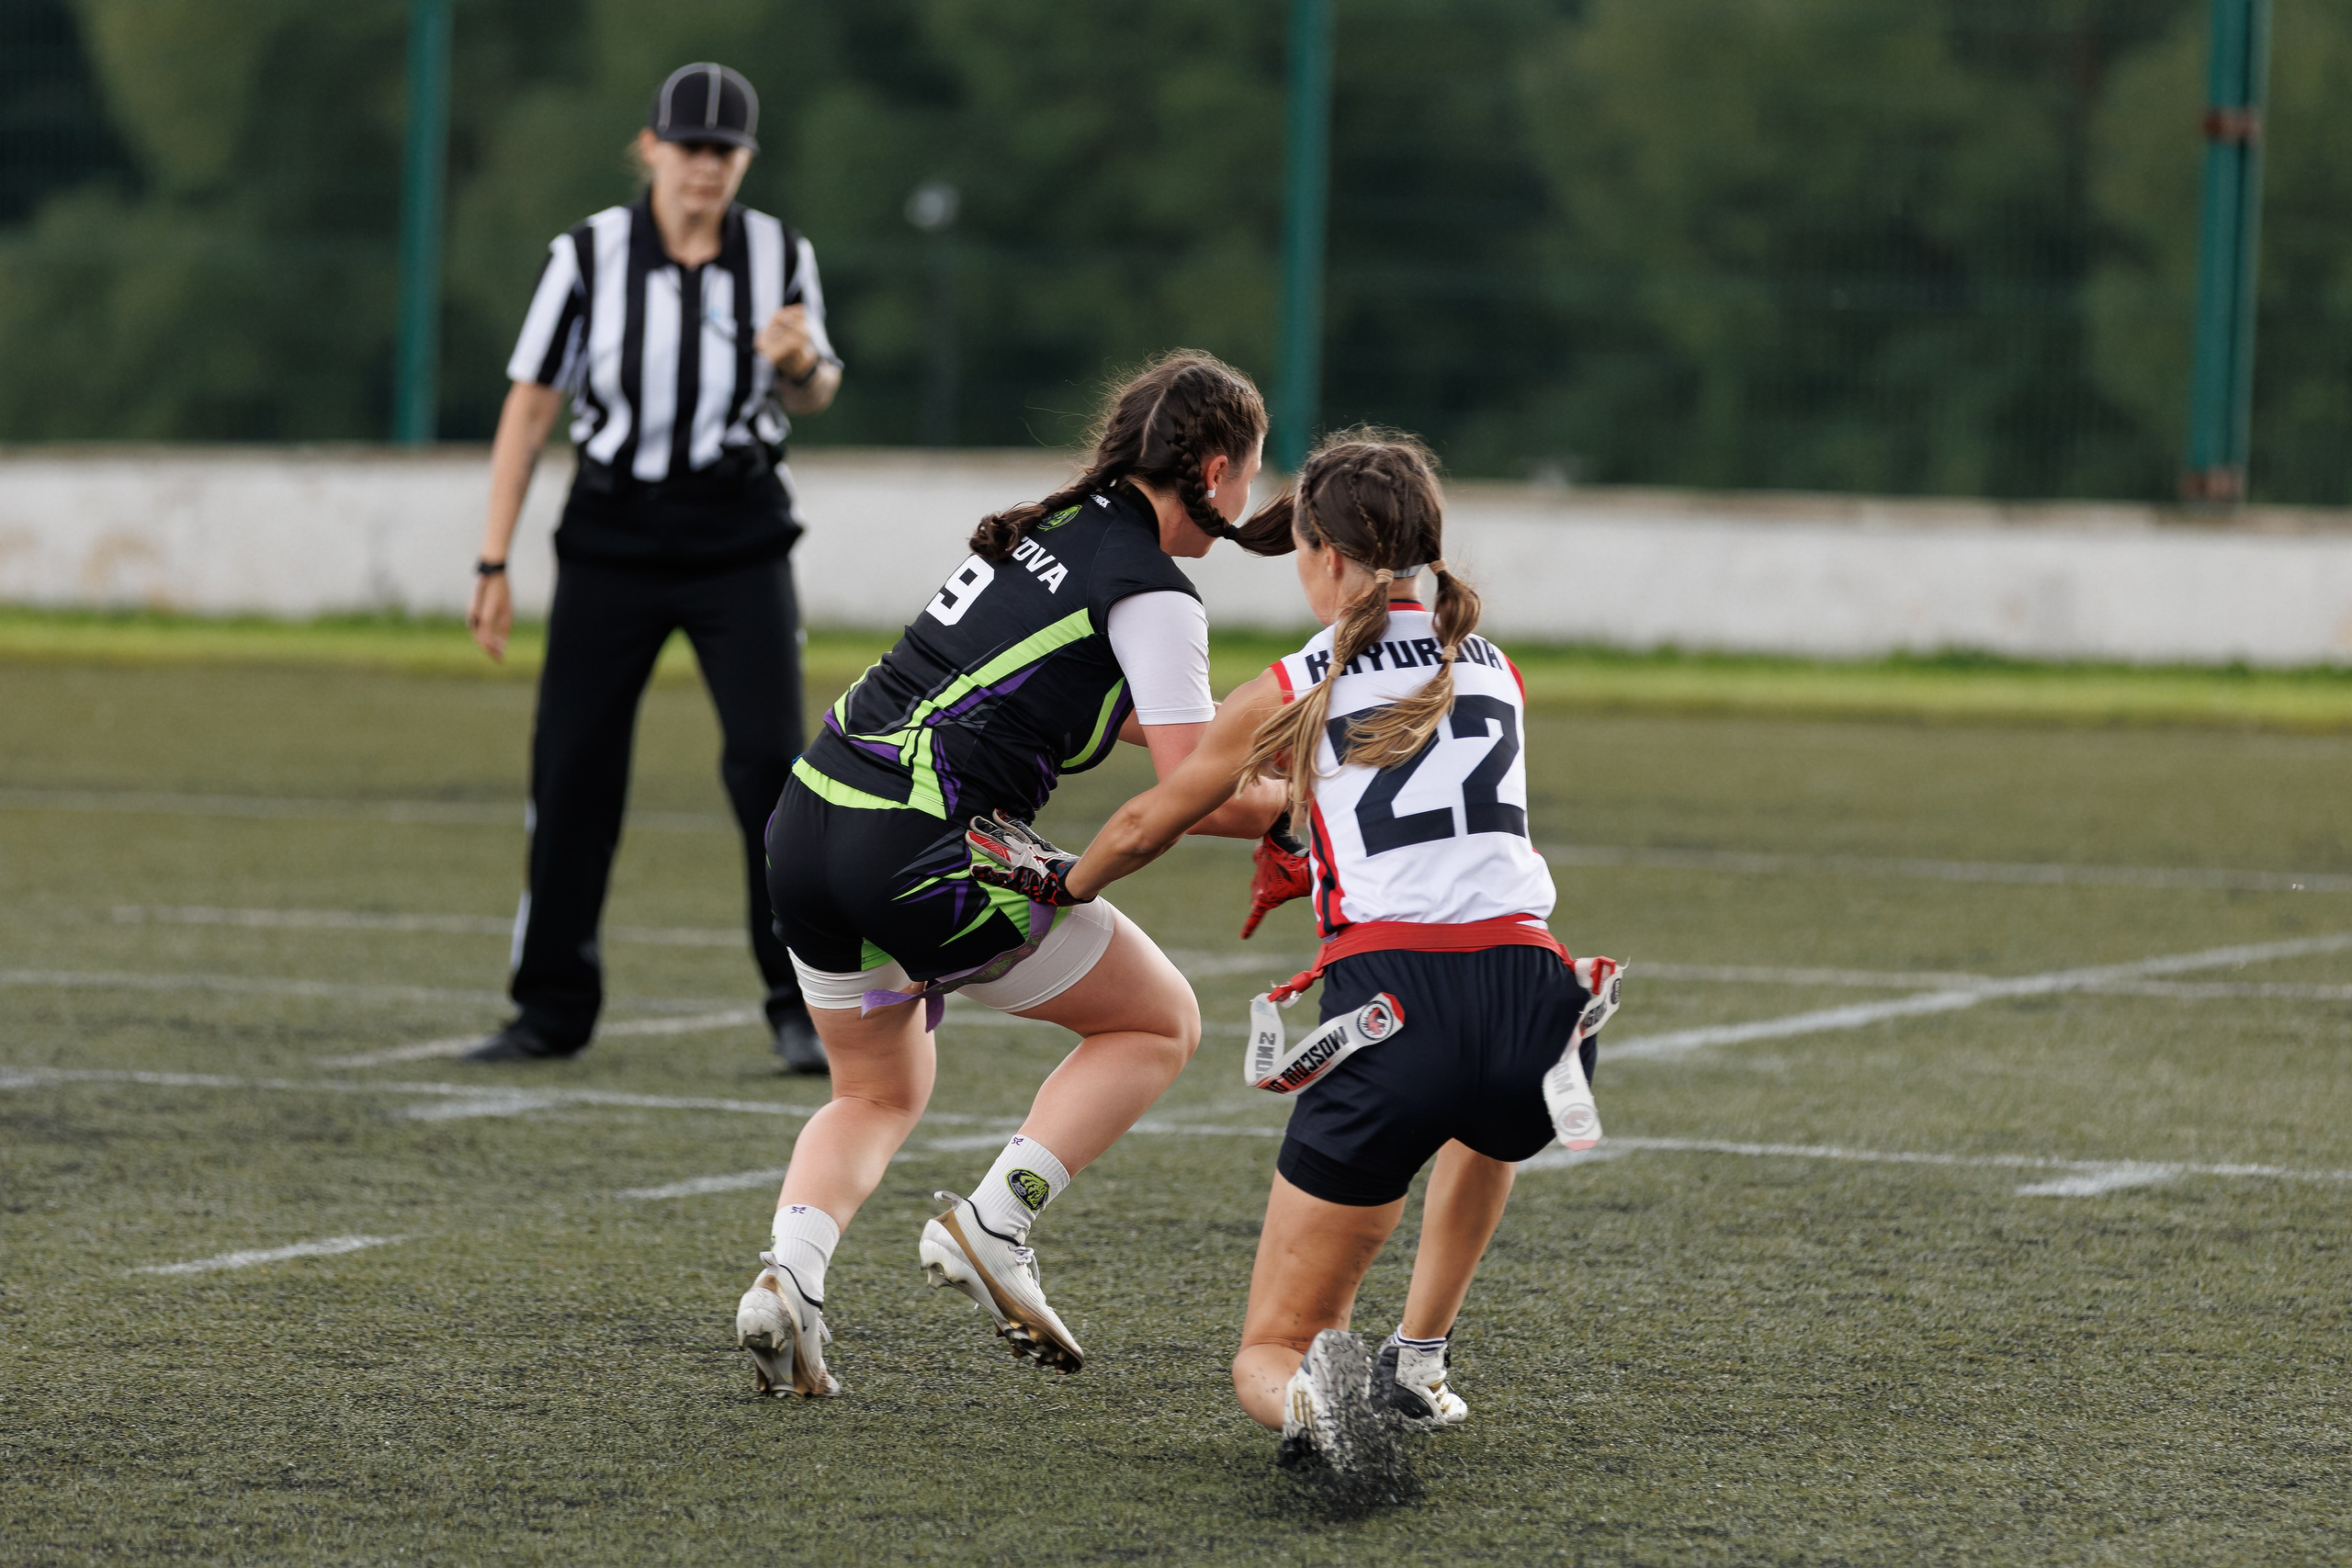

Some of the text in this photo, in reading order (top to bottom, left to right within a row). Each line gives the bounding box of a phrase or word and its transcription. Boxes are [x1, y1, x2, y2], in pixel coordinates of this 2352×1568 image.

[925, 554, 995, 626] 9
[1011, 536, 1069, 594] OVA
[1325, 694, 1527, 857] 22
[1280, 1025, 1351, 1087] MOSCOW
